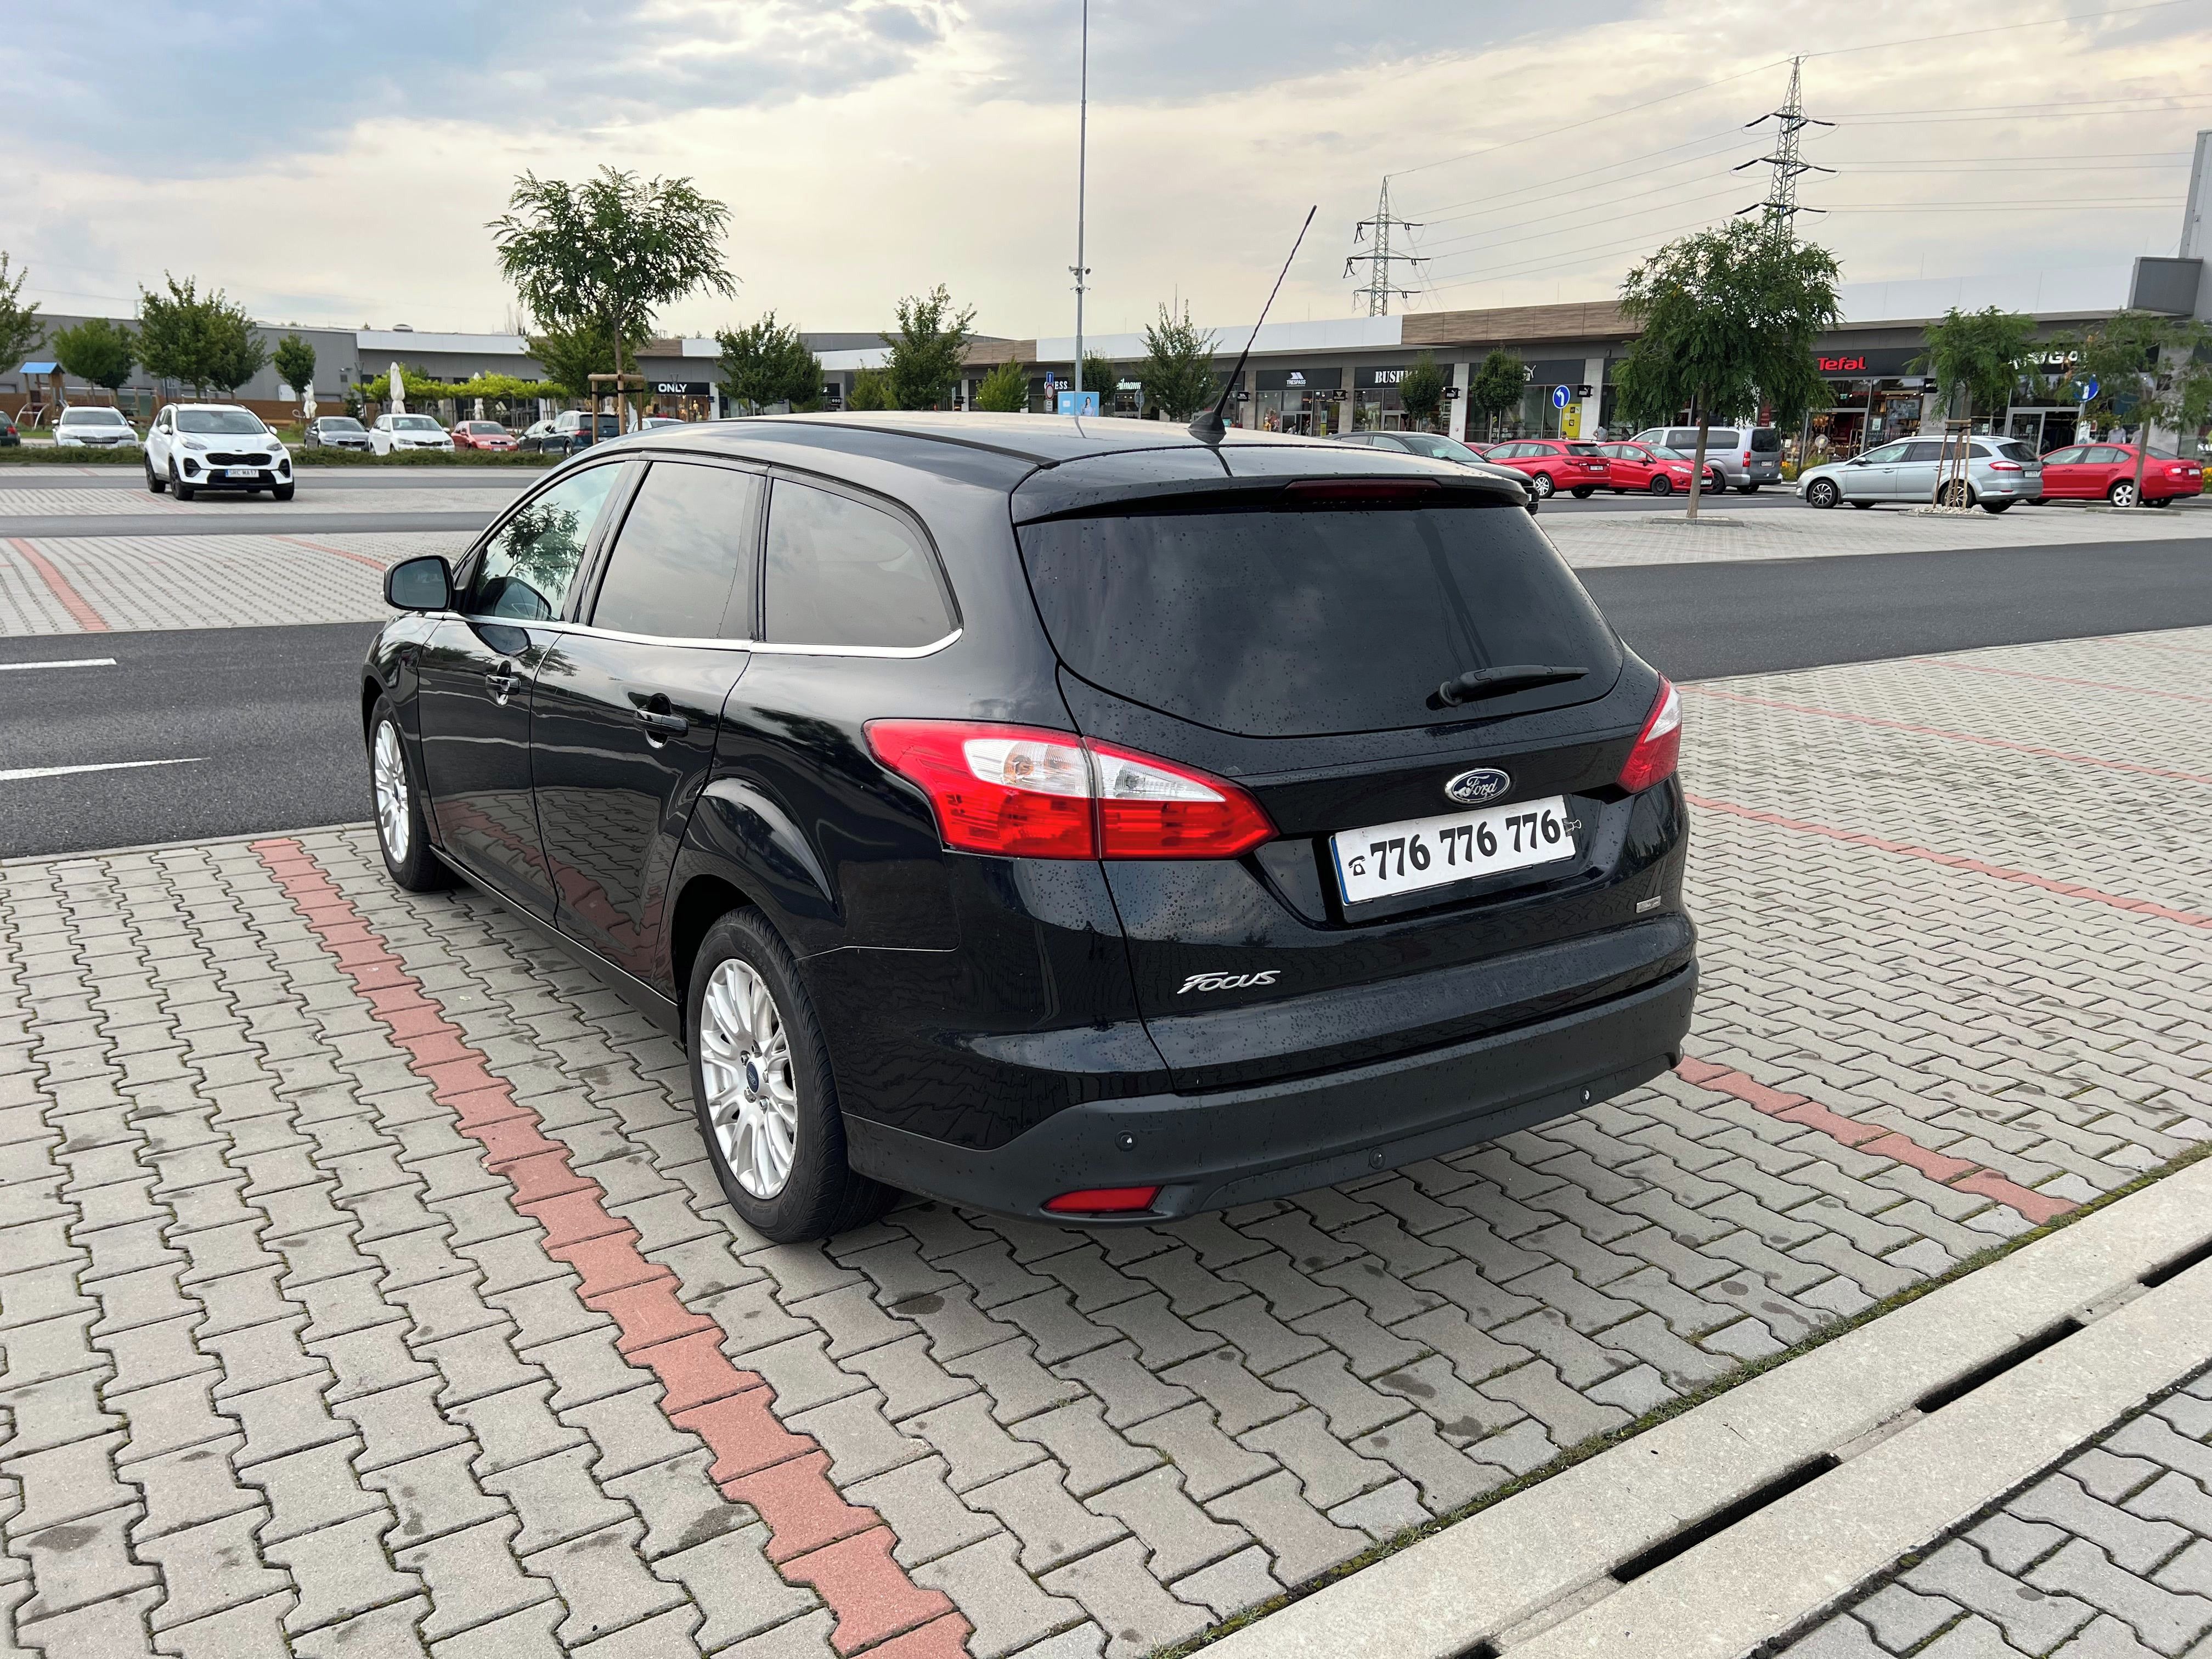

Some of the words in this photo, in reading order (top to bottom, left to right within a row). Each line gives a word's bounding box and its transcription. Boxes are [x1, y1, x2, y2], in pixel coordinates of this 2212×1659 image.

[1817, 357, 1867, 371] Tefal
[658, 383, 687, 393] ONLY
[1454, 774, 1498, 797] Ford
[1370, 833, 1431, 880] 776
[1440, 821, 1497, 866] 776
[1505, 809, 1561, 853] 776
